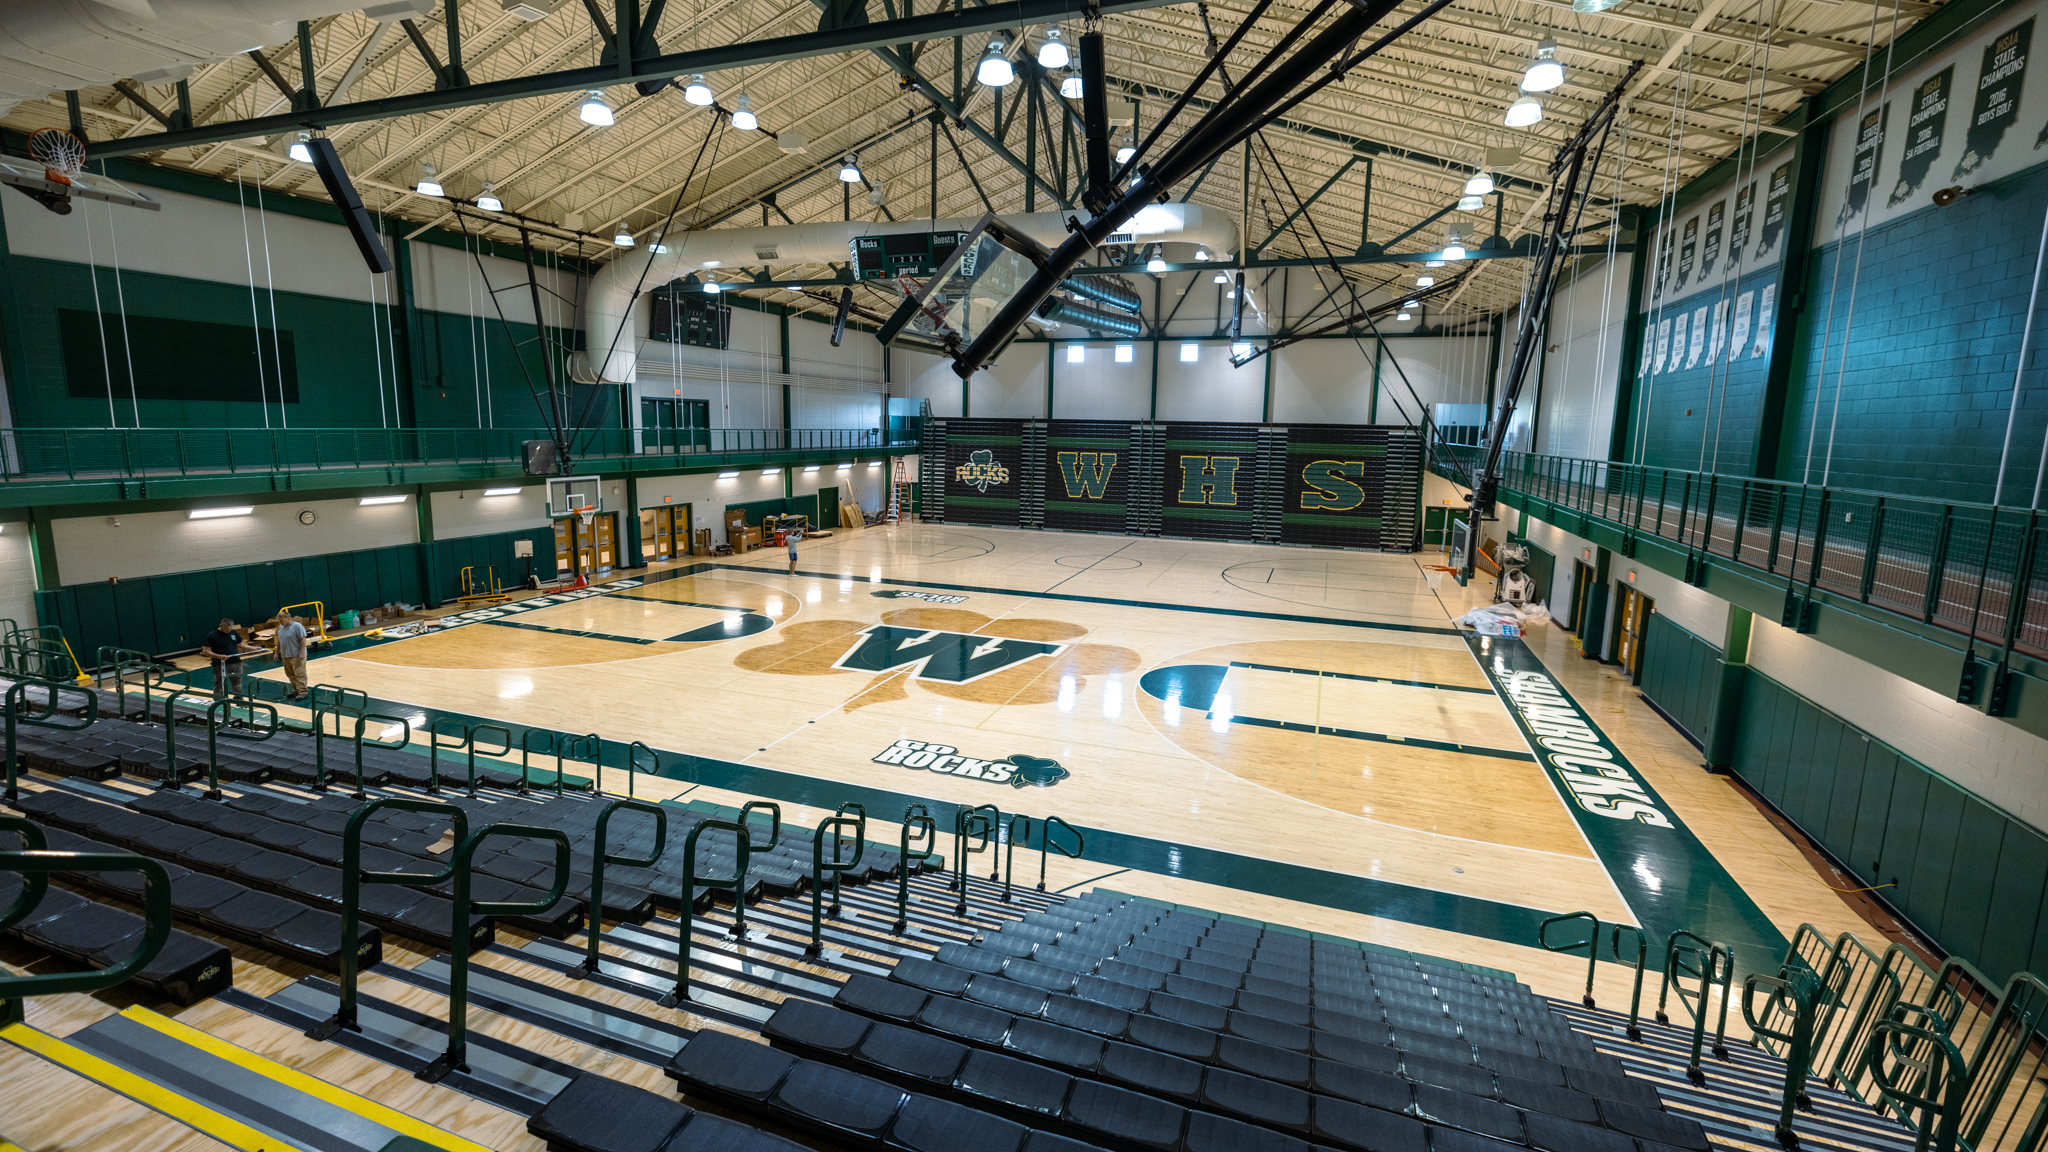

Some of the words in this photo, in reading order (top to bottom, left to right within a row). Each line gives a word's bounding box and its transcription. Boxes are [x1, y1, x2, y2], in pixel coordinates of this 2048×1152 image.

[1993, 46, 2017, 70] STATE
[1980, 55, 2025, 90] CHAMPIONS
[1921, 89, 1940, 110] STATE
[1988, 87, 2007, 108] 2016
[1911, 98, 1947, 127] CHAMPIONS
[1978, 107, 1996, 125] BOYS
[1995, 99, 2013, 117] GOLF
[1914, 136, 1938, 156] FOOTBALL
[860, 240, 878, 249] Rocks
[933, 236, 955, 244] Guests
[899, 266, 918, 275] period
[955, 464, 1010, 483] ROCKS
[1057, 451, 1117, 498] W
[1178, 455, 1240, 505] H
[1301, 460, 1365, 510] S
[440, 580, 644, 628] ESTFIELD
[831, 624, 1071, 686] W
[895, 739, 958, 755] GO
[1490, 667, 1675, 829] SHAMROCKS
[873, 745, 1019, 782] ROCKS
